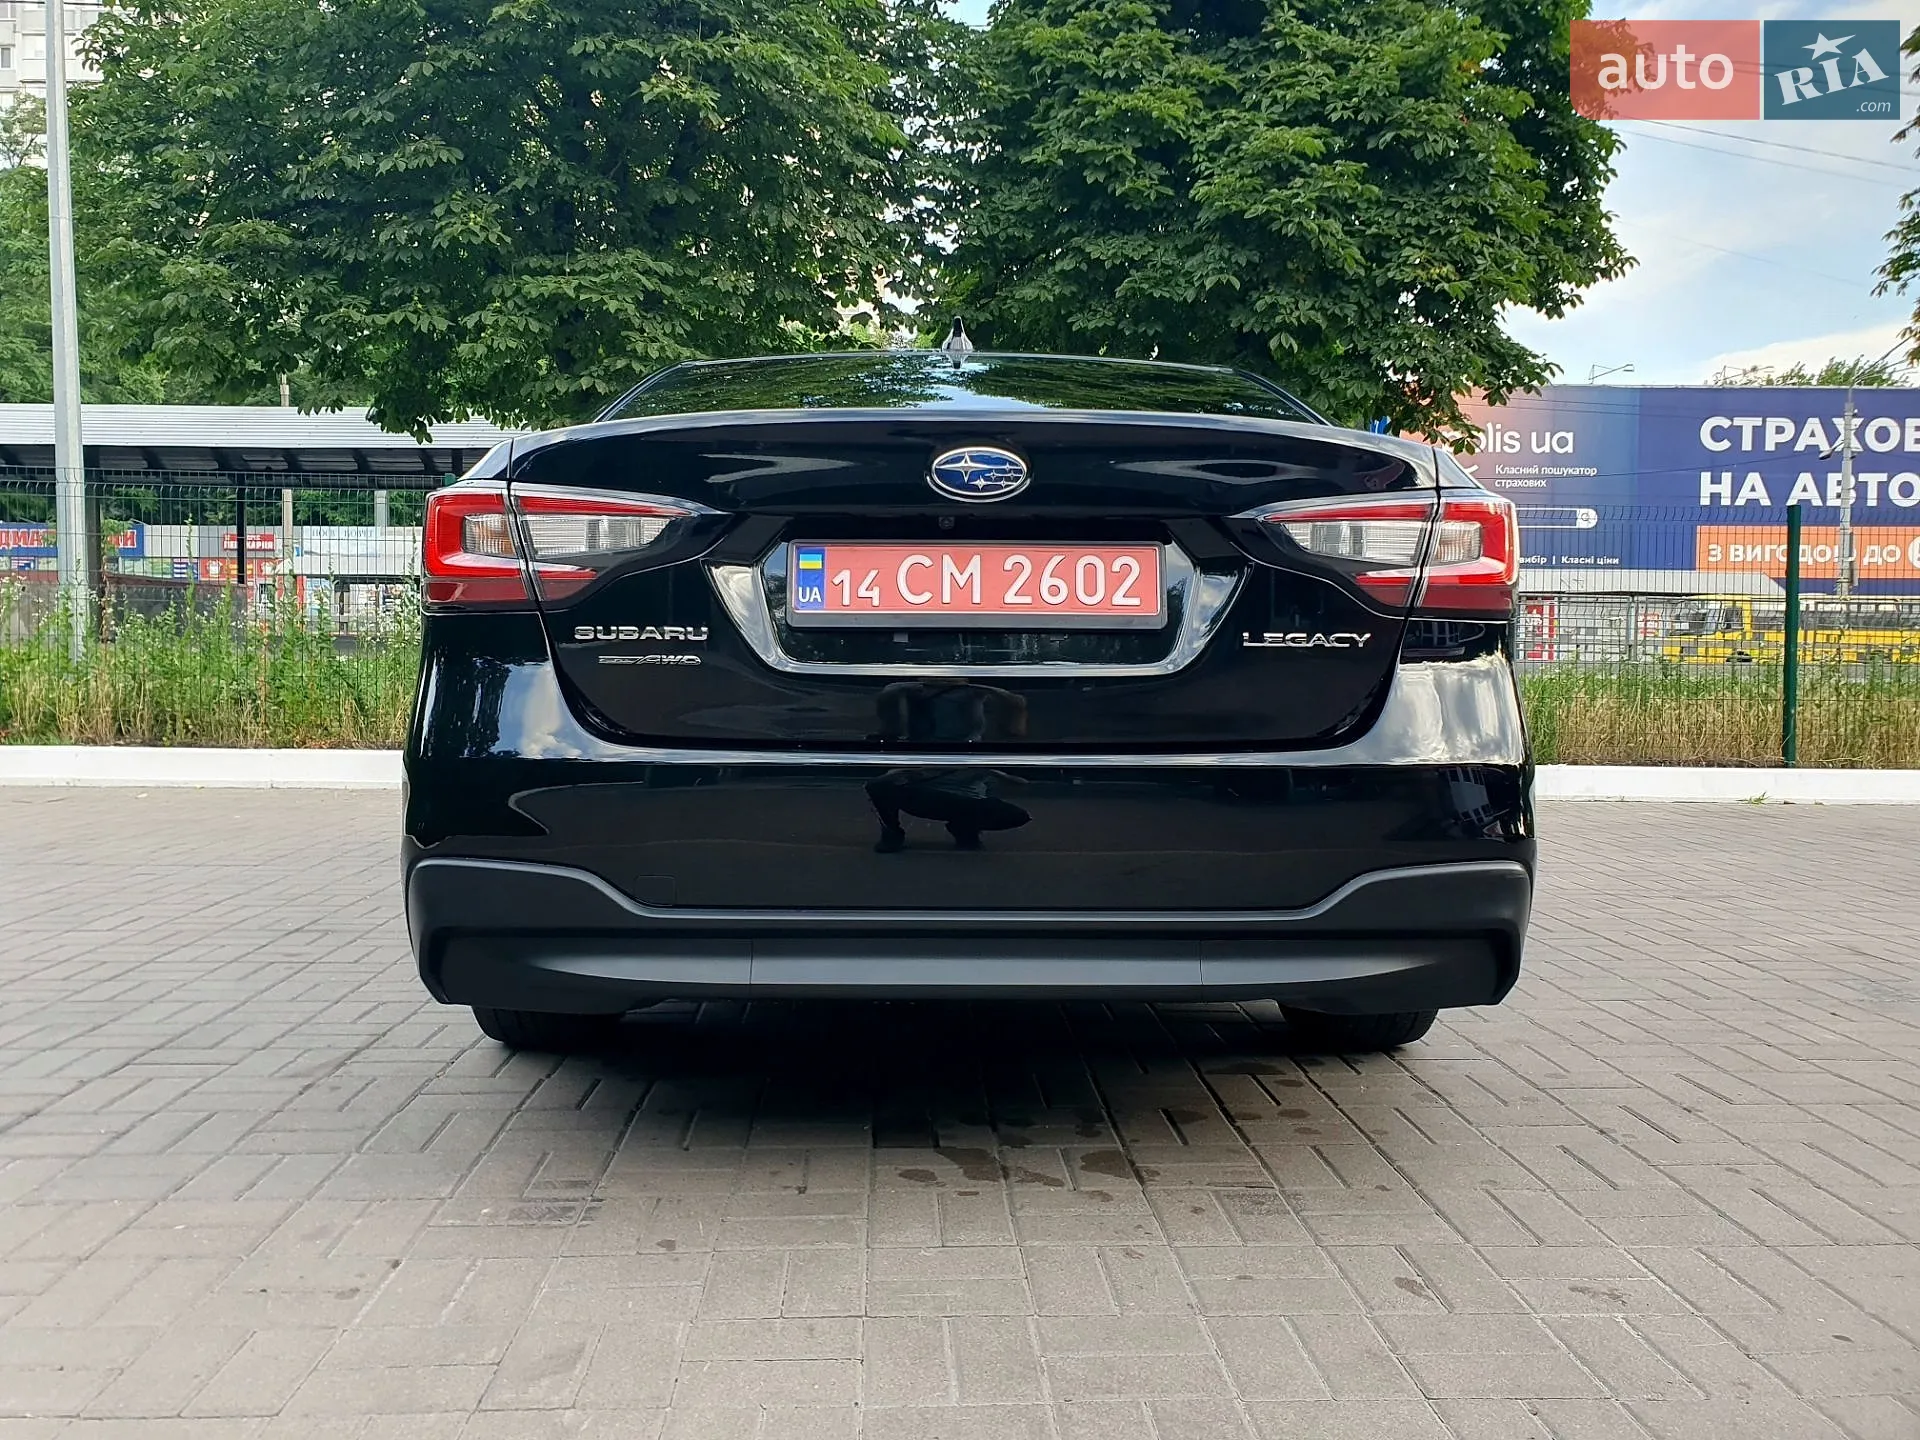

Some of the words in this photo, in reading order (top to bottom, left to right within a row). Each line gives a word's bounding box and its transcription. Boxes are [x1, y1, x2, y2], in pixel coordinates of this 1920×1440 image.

[1531, 431, 1574, 454] ua
[1495, 464, 1539, 475] Класний
[1541, 466, 1597, 477] пошукатор
[1495, 479, 1547, 489] страхових
[1700, 471, 1771, 506] НА
[1786, 472, 1920, 507] АВТО
[1561, 556, 1594, 564] Класні
[1597, 556, 1619, 565] ціни
[1708, 544, 1722, 562] З
[1863, 545, 1901, 565] ДО
[832, 569, 880, 607] 14
[896, 554, 984, 605] CM
[1003, 554, 1141, 606] 2602
[798, 587, 822, 603] UA
[574, 626, 708, 640] SUBARU
[1242, 632, 1371, 647] LEGACY
